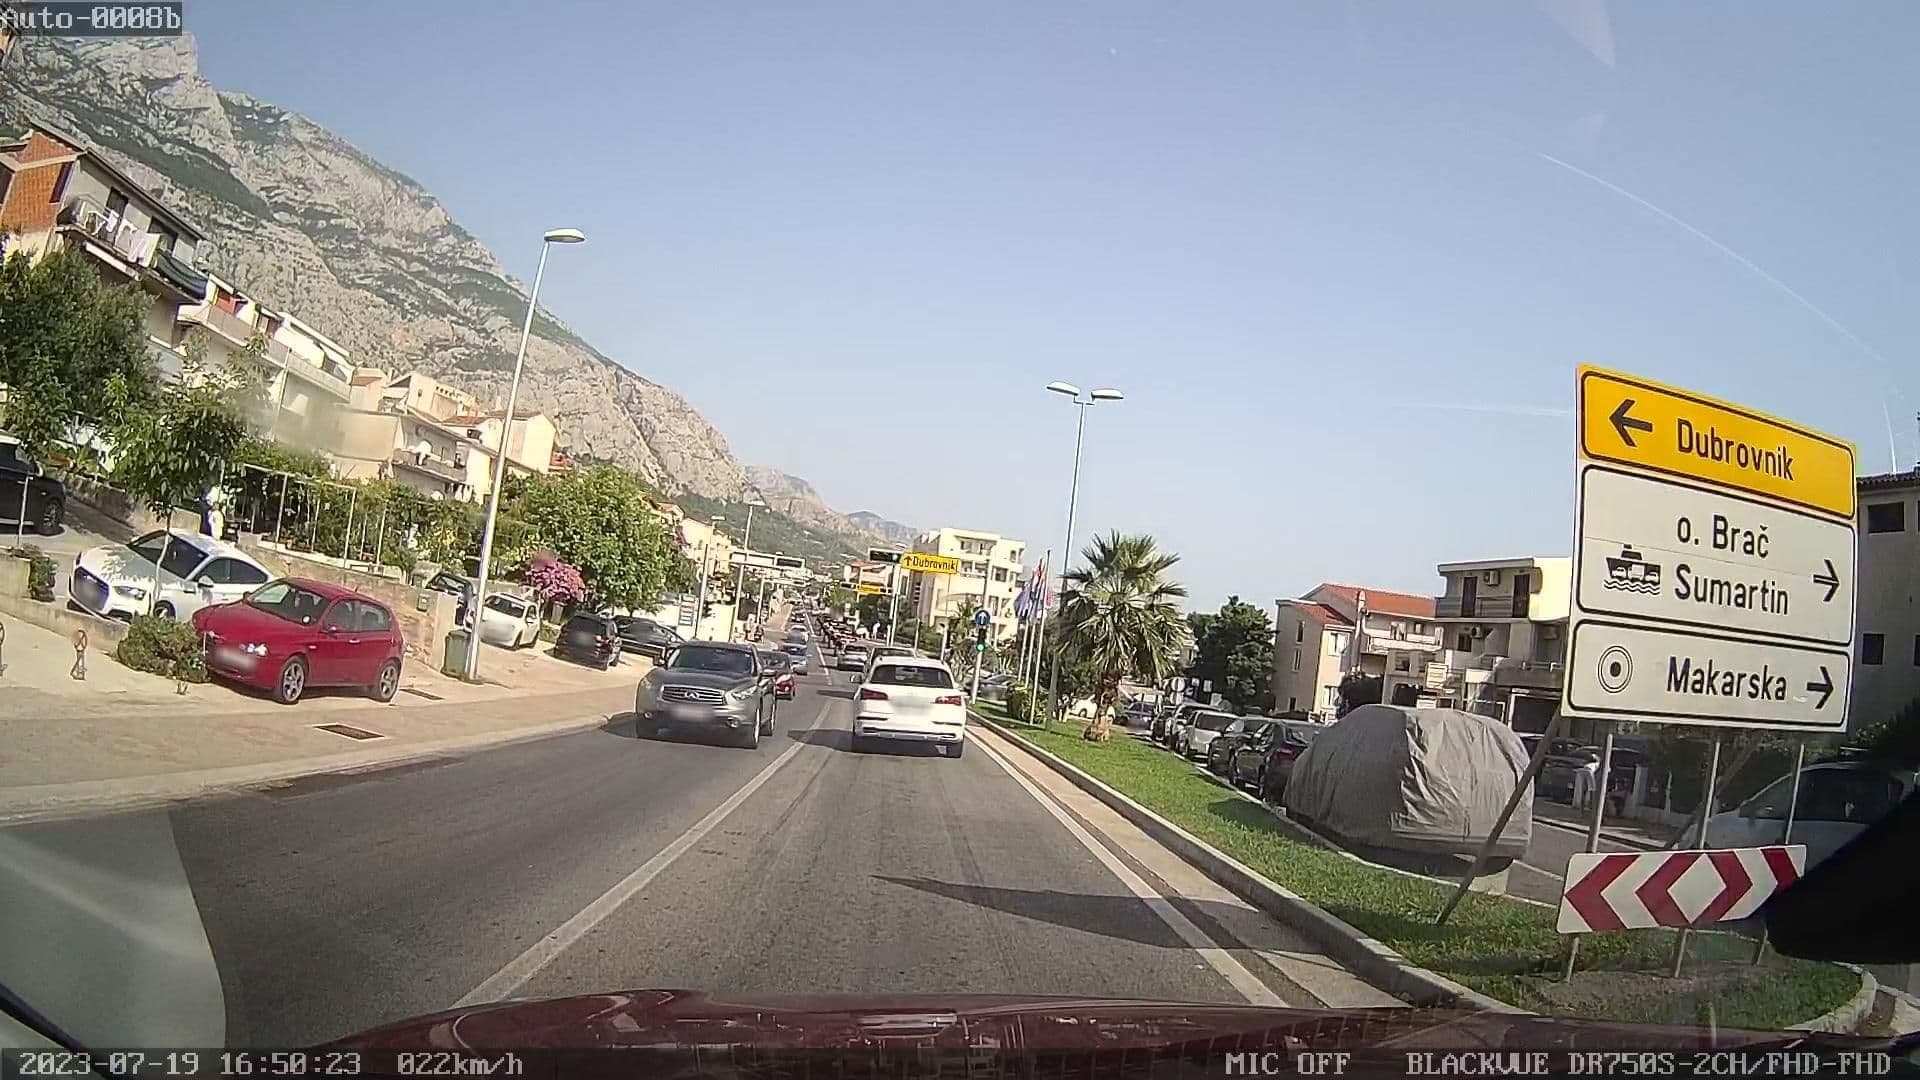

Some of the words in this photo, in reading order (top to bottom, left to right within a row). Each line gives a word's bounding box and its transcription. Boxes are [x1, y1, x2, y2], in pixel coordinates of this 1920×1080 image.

[1677, 418, 1794, 481] Dubrovnik
[1677, 517, 1700, 545] o.
[1712, 514, 1769, 558] Brač
[913, 556, 955, 570] Dubrovnik
[1674, 564, 1789, 615] Sumartin
[1667, 656, 1787, 701] Makarska
